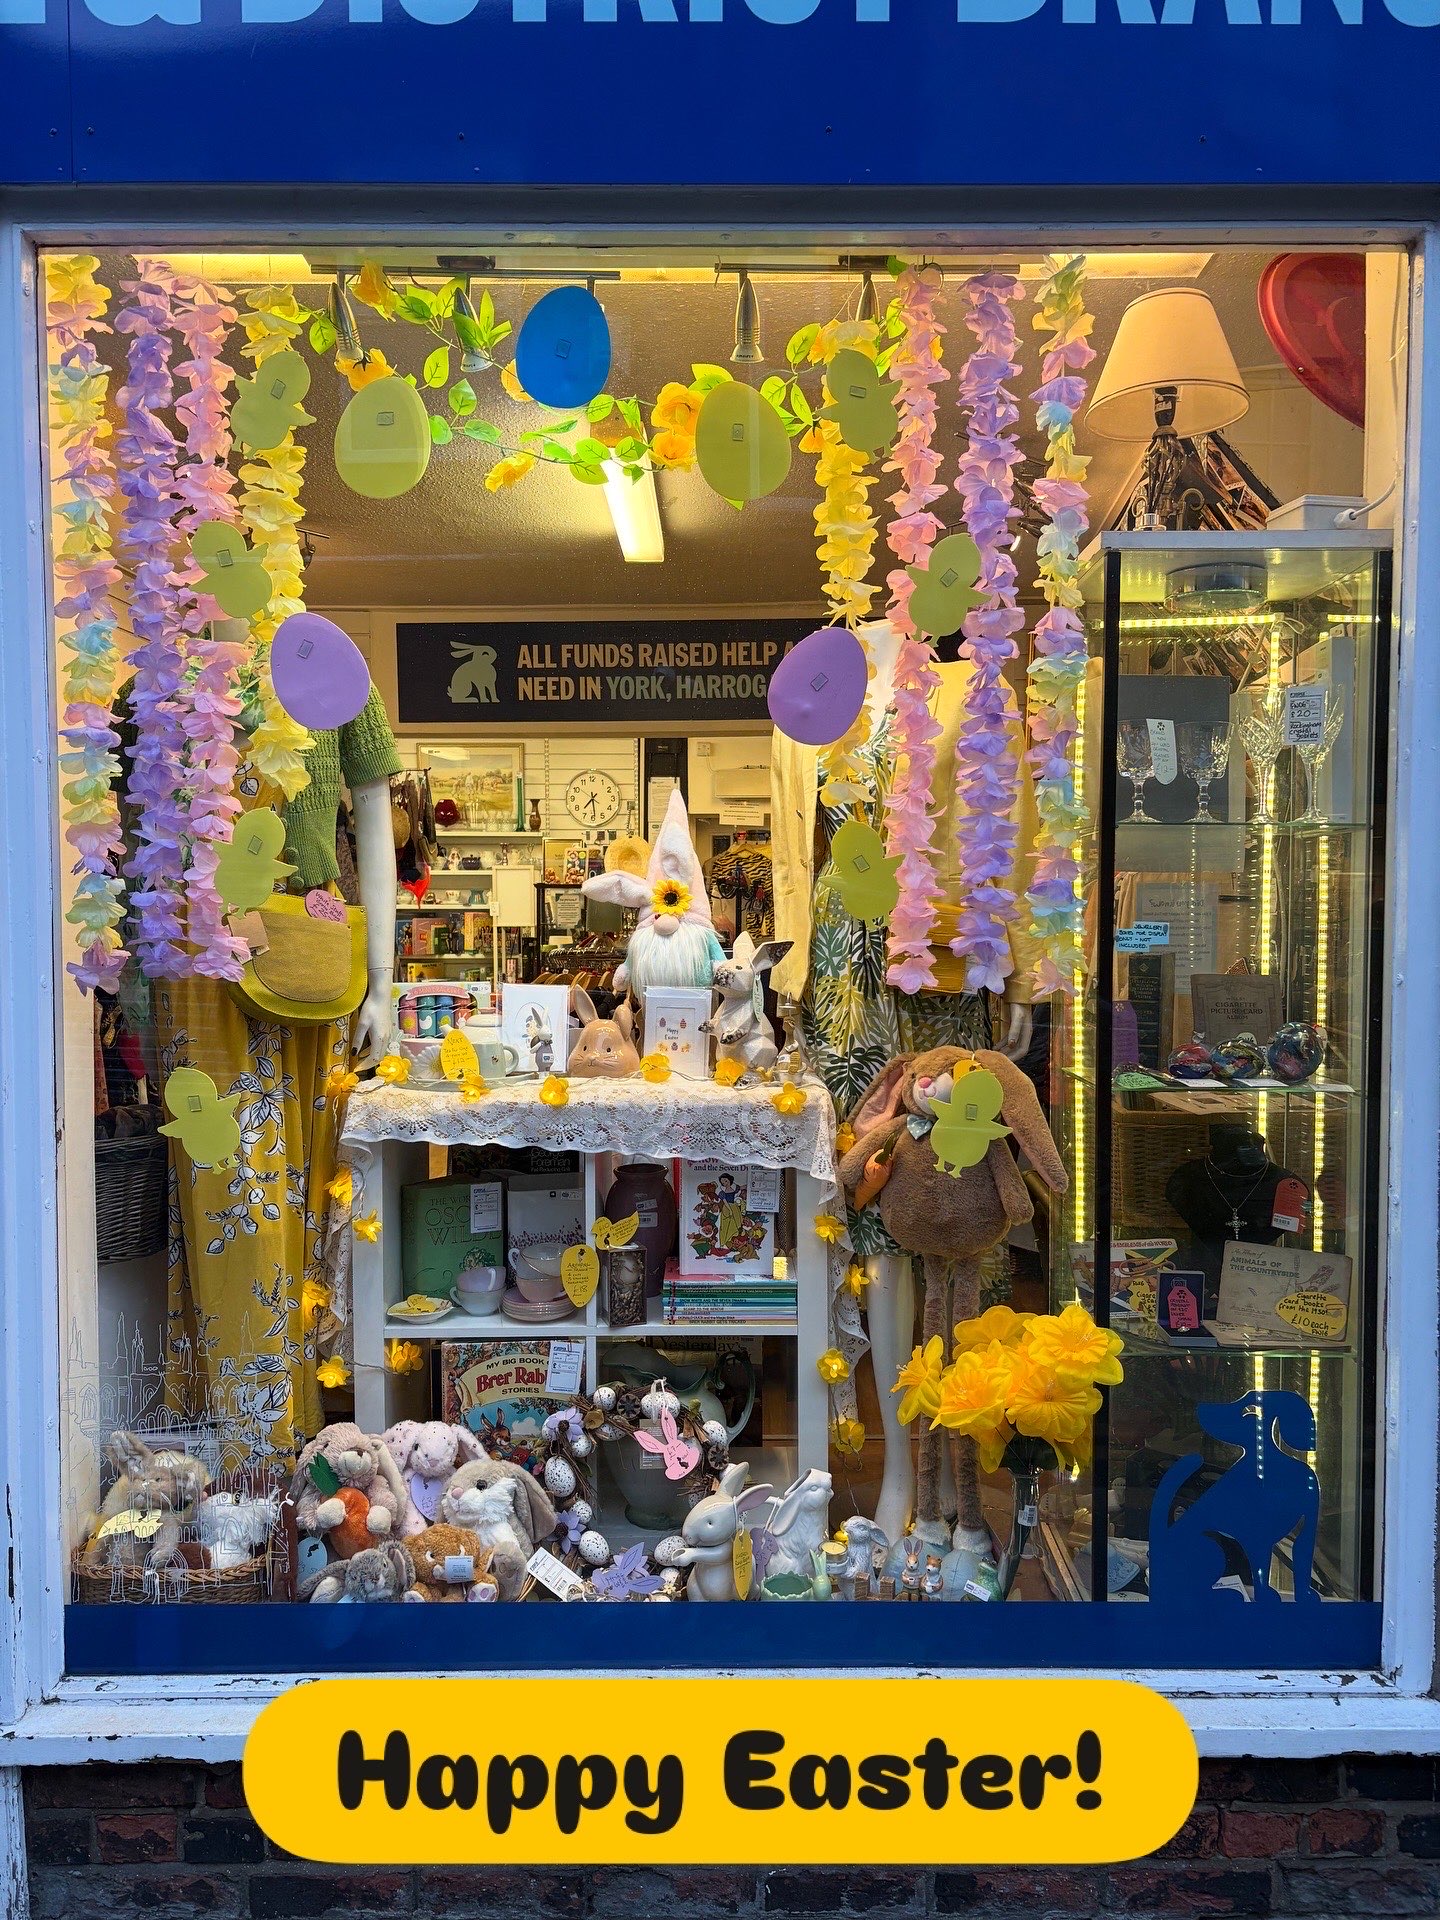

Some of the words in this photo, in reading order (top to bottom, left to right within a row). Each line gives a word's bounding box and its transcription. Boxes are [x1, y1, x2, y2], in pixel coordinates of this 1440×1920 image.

[517, 644, 557, 669] ALL
[561, 643, 634, 669] FUNDS
[638, 642, 717, 668] RAISED
[722, 641, 778, 666] HELP
[518, 676, 575, 701] NEED
[579, 676, 601, 700] IN
[605, 675, 672, 702] YORK,
[531, 1159, 571, 1167] Foreman
[430, 1198, 447, 1206] THE
[1230, 1257, 1268, 1267] ANIMALS
[1229, 1264, 1245, 1272] THE
[1245, 1266, 1300, 1279] COUNTRYSIDE
[1296, 1292, 1327, 1301] Cigarette
[1298, 1304, 1310, 1313] the
[486, 1361, 500, 1370] MY
[502, 1358, 517, 1366] BIG
[519, 1357, 545, 1365] BOOK
[476, 1371, 513, 1394] Brer
[502, 1386, 540, 1395] STORIES
